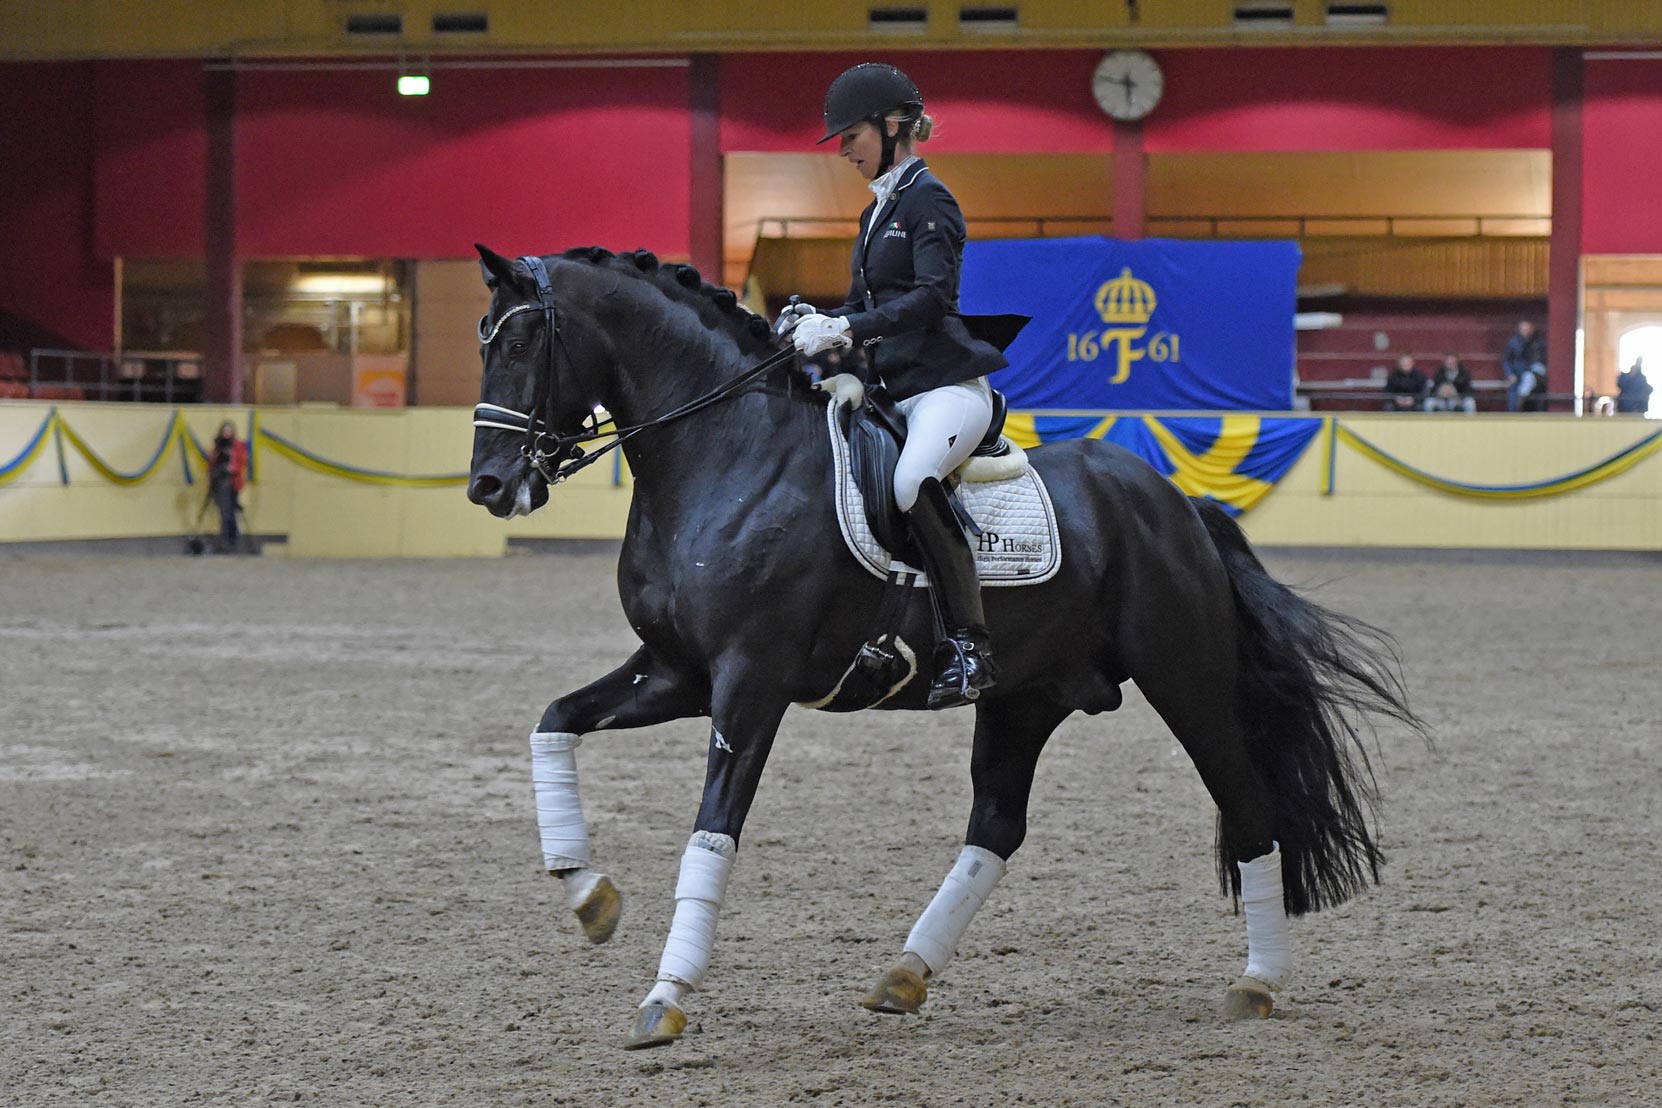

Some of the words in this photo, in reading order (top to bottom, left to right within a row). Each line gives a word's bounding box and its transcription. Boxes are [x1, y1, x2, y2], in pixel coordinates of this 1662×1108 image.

[1067, 330, 1099, 362] 16
[1148, 331, 1180, 363] 61
[1001, 538, 1042, 553] HORSES
